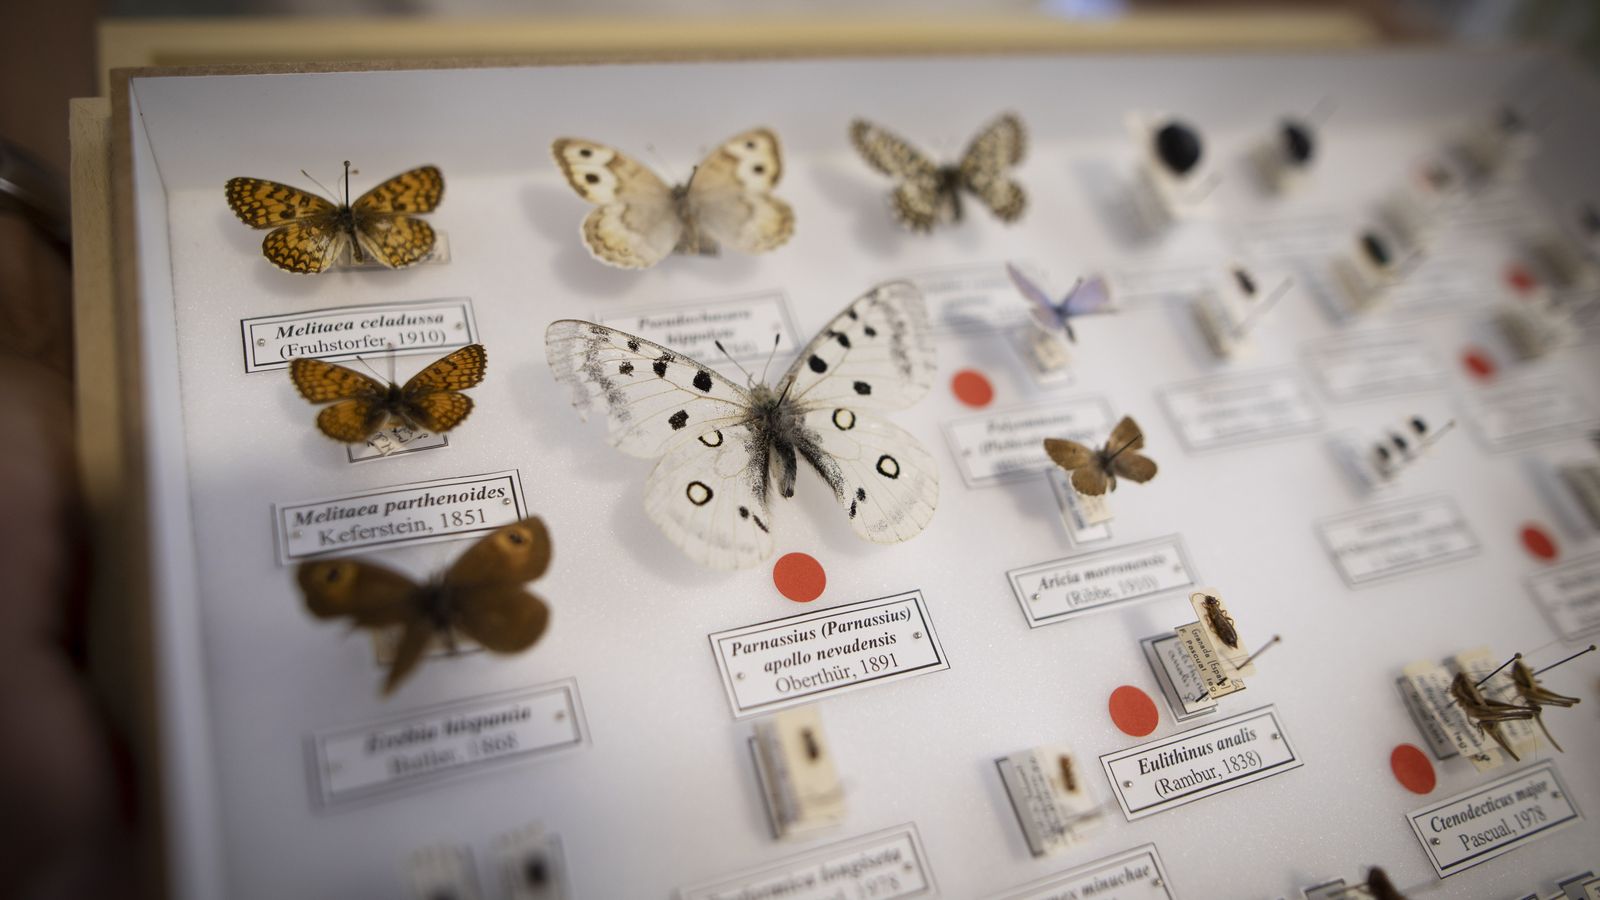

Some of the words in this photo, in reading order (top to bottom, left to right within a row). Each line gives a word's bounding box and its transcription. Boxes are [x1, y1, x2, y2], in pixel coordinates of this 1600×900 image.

[275, 318, 354, 340] Melitaea
[360, 311, 444, 330] celadussa
[279, 335, 388, 360] (Fruhstorfer
[397, 330, 446, 347] 1910)
[294, 502, 379, 527] Melitaea
[384, 485, 506, 516] parthenoides
[318, 519, 433, 547] Keferstein,
[440, 508, 487, 529] 1851
[1037, 570, 1081, 591] Aricia
[731, 628, 817, 657] Parnassius
[821, 606, 912, 639] (Parnassius)
[764, 651, 812, 675] apollo
[816, 631, 897, 661] nevadensis
[775, 666, 857, 693] Oberthür,
[860, 652, 899, 675] 1891
[1186, 640, 1207, 672] Pascual
[1137, 741, 1214, 776] Eulithinus
[1216, 726, 1258, 751] analis
[1154, 764, 1223, 799] (Rambur,
[1222, 750, 1264, 775] 1838)
[1430, 792, 1515, 833] Ctenodecticus
[1515, 780, 1549, 805] major
[1459, 822, 1517, 851] Pascual,
[1514, 805, 1548, 830] 1978
[1081, 864, 1150, 896] minuchae
